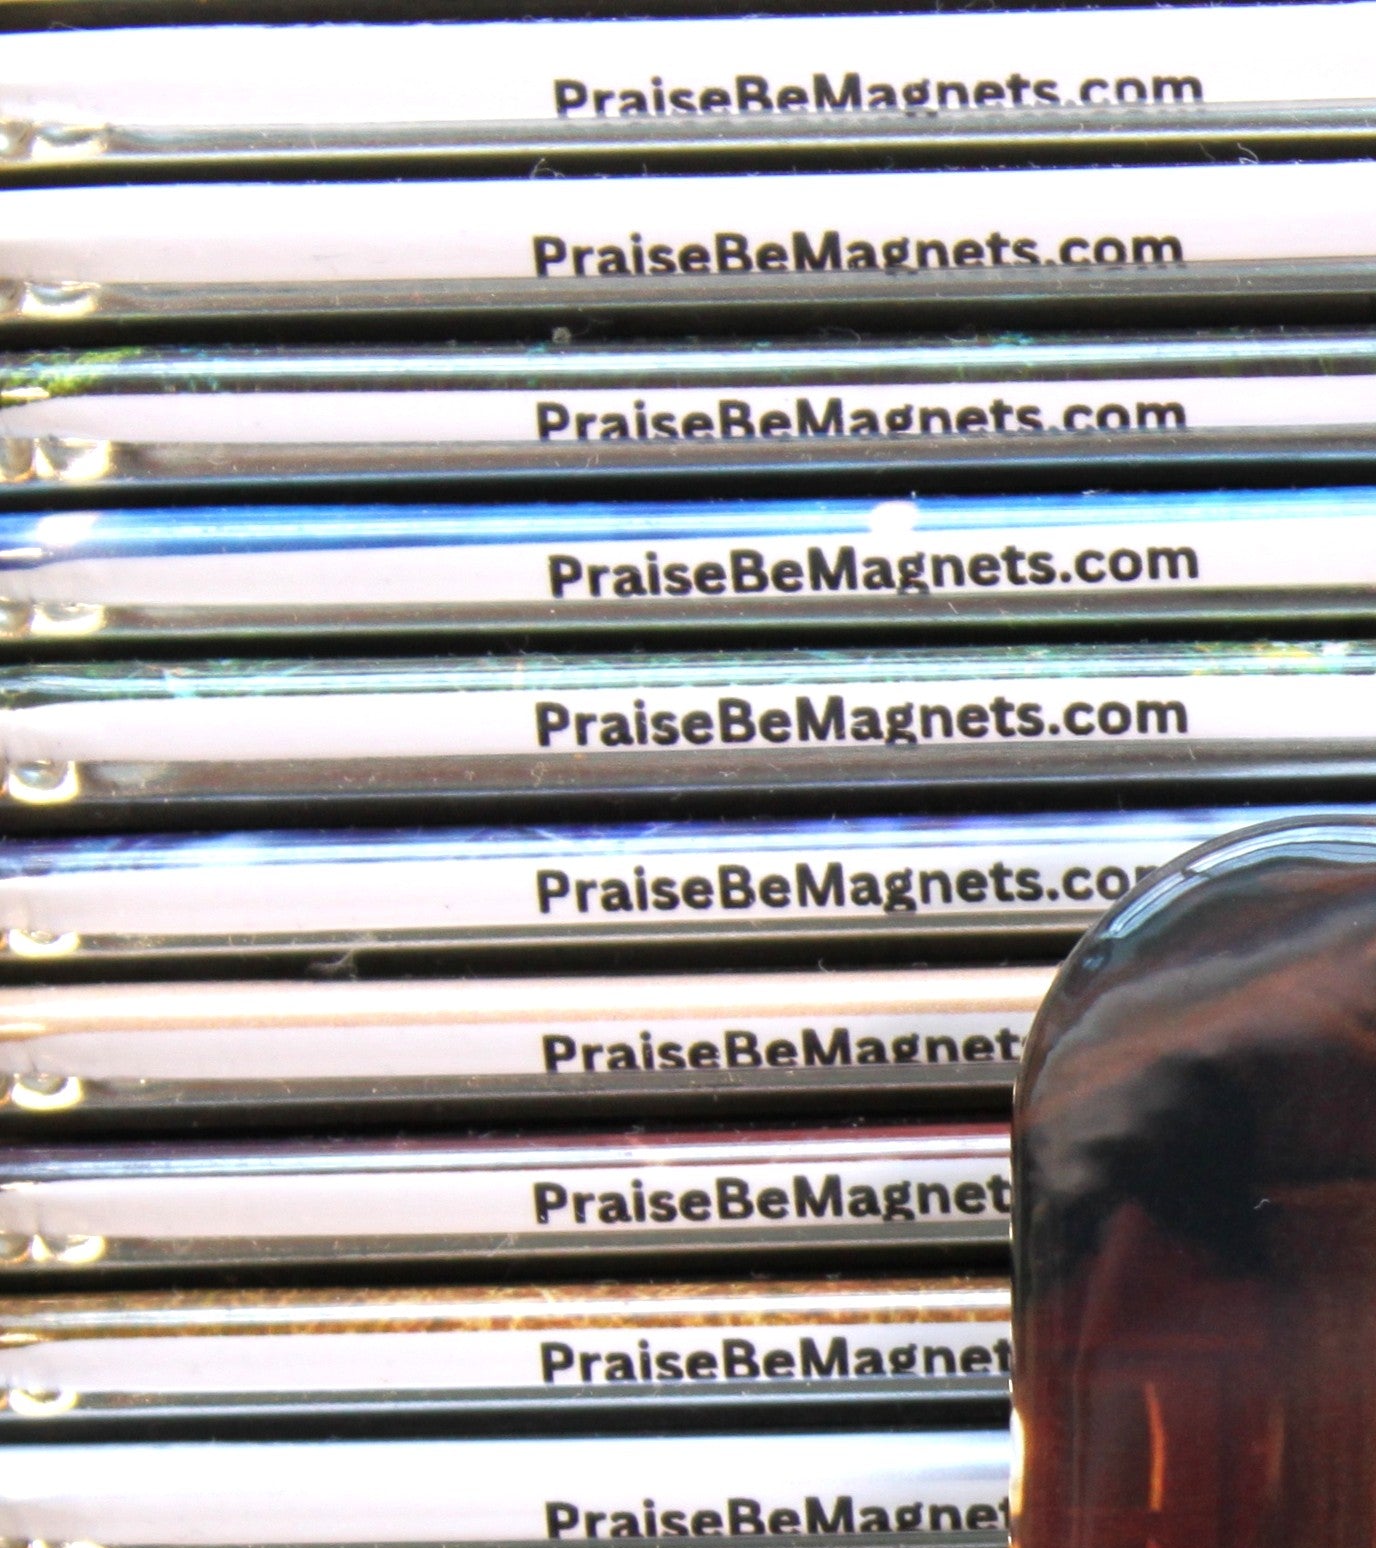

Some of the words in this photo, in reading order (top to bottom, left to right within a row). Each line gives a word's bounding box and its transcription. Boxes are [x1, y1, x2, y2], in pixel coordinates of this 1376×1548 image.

[533, 231, 1185, 278] PraiseBeMagnets.com
[536, 398, 1188, 442] PraiseBeMagnets.com
[548, 545, 1200, 598] PraiseBeMagnets.com
[535, 695, 1189, 748] PraiseBeMagnets.com
[536, 862, 1159, 914] PraiseBeMagnets.co
